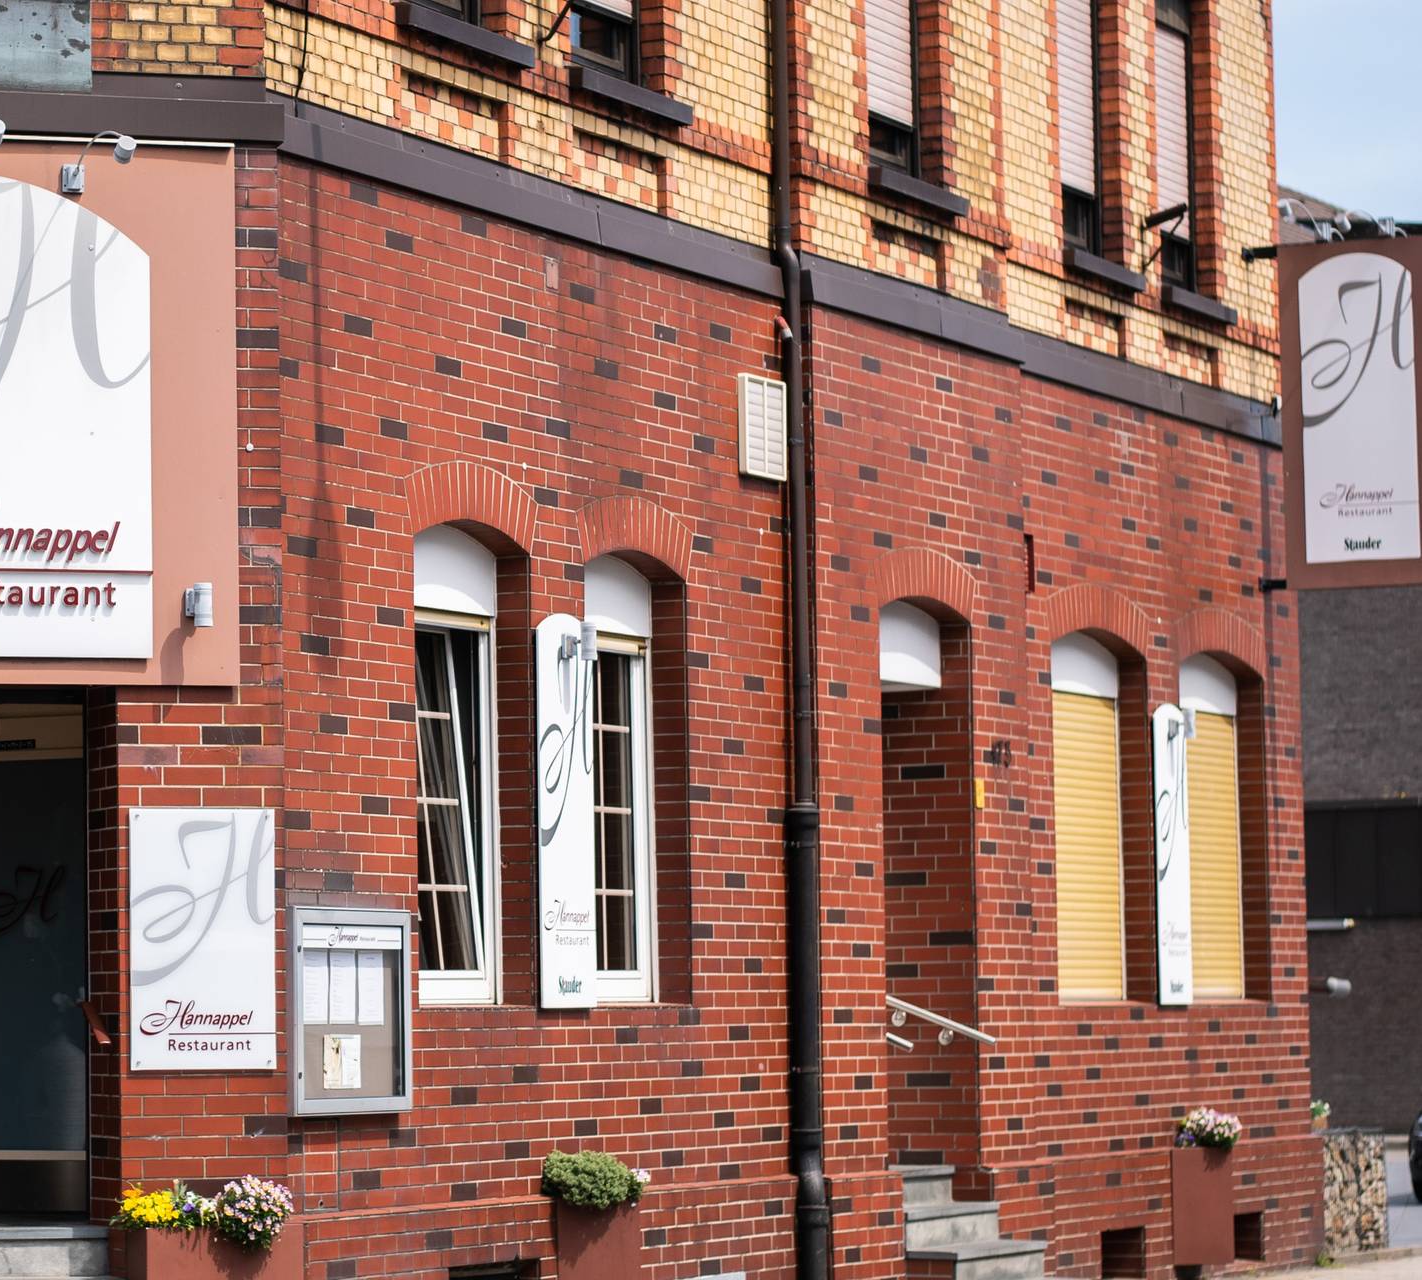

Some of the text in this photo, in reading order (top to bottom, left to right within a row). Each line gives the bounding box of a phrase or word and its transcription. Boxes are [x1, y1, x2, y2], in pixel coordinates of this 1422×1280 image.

[1344, 536, 1382, 551] Stauder
[555, 934, 590, 946] Restaurant
[139, 999, 254, 1036] Hannappel
[167, 1038, 252, 1051] Restaurant
